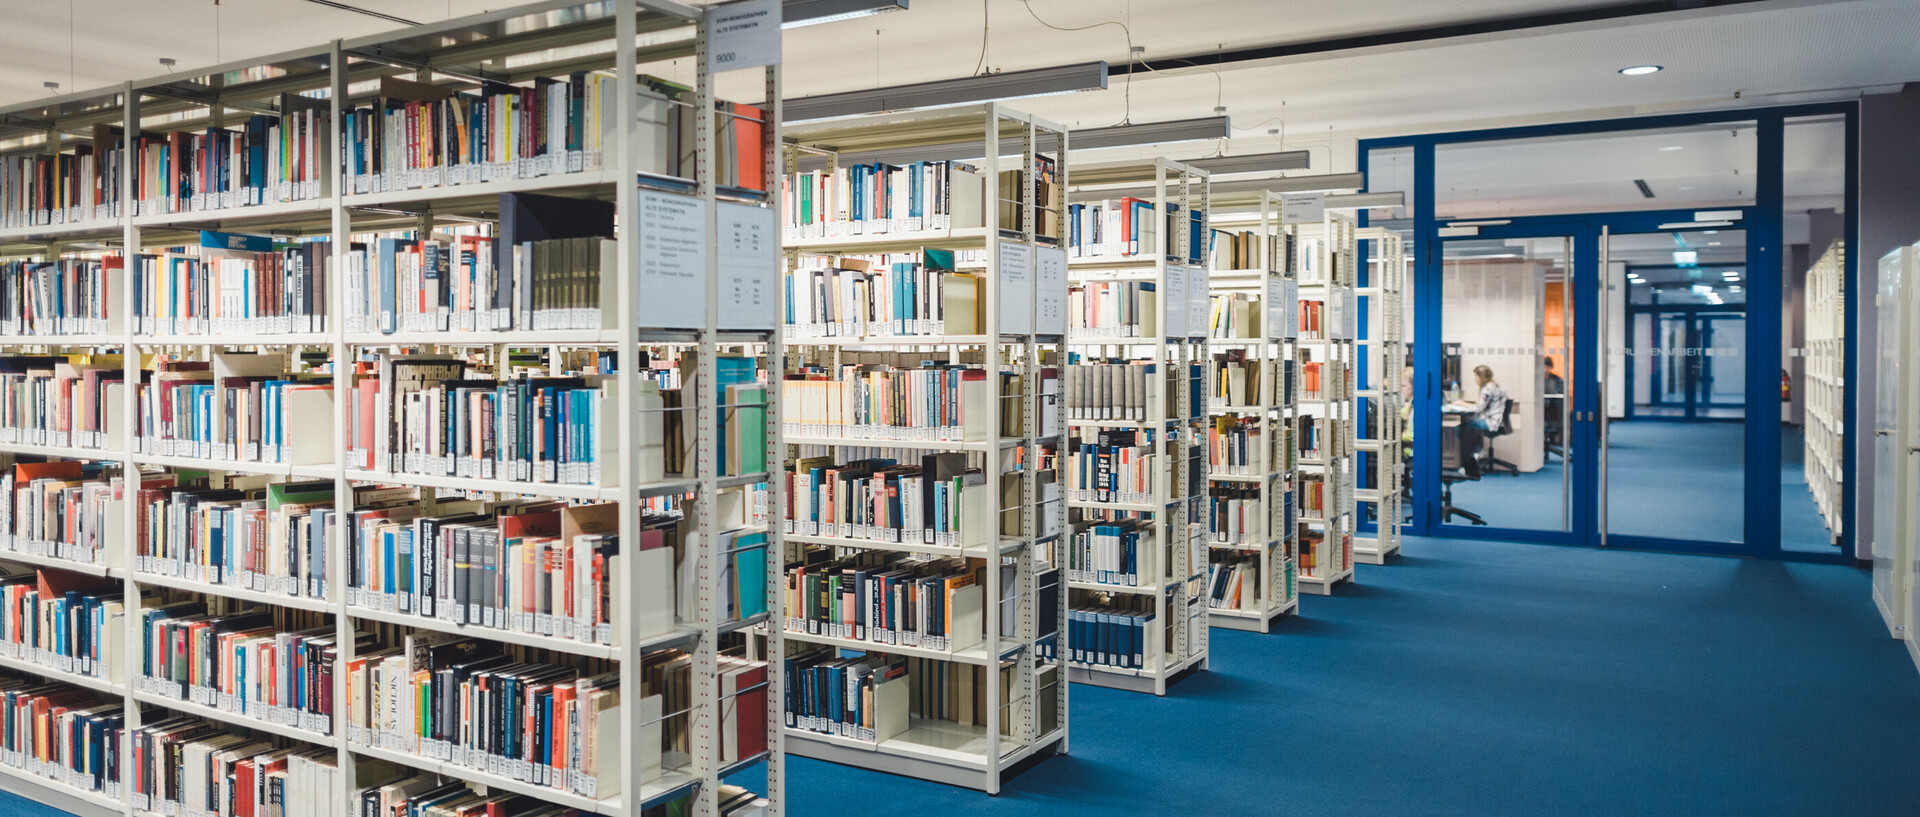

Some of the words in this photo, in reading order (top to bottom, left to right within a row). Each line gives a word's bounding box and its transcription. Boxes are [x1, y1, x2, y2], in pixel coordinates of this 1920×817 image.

[729, 22, 759, 31] SYSTEMATIK
[716, 52, 736, 63] 9000
[1614, 347, 1703, 357] GRUPPENARBEIT
[396, 364, 461, 381] КОРИЧНЕВЫЙ
